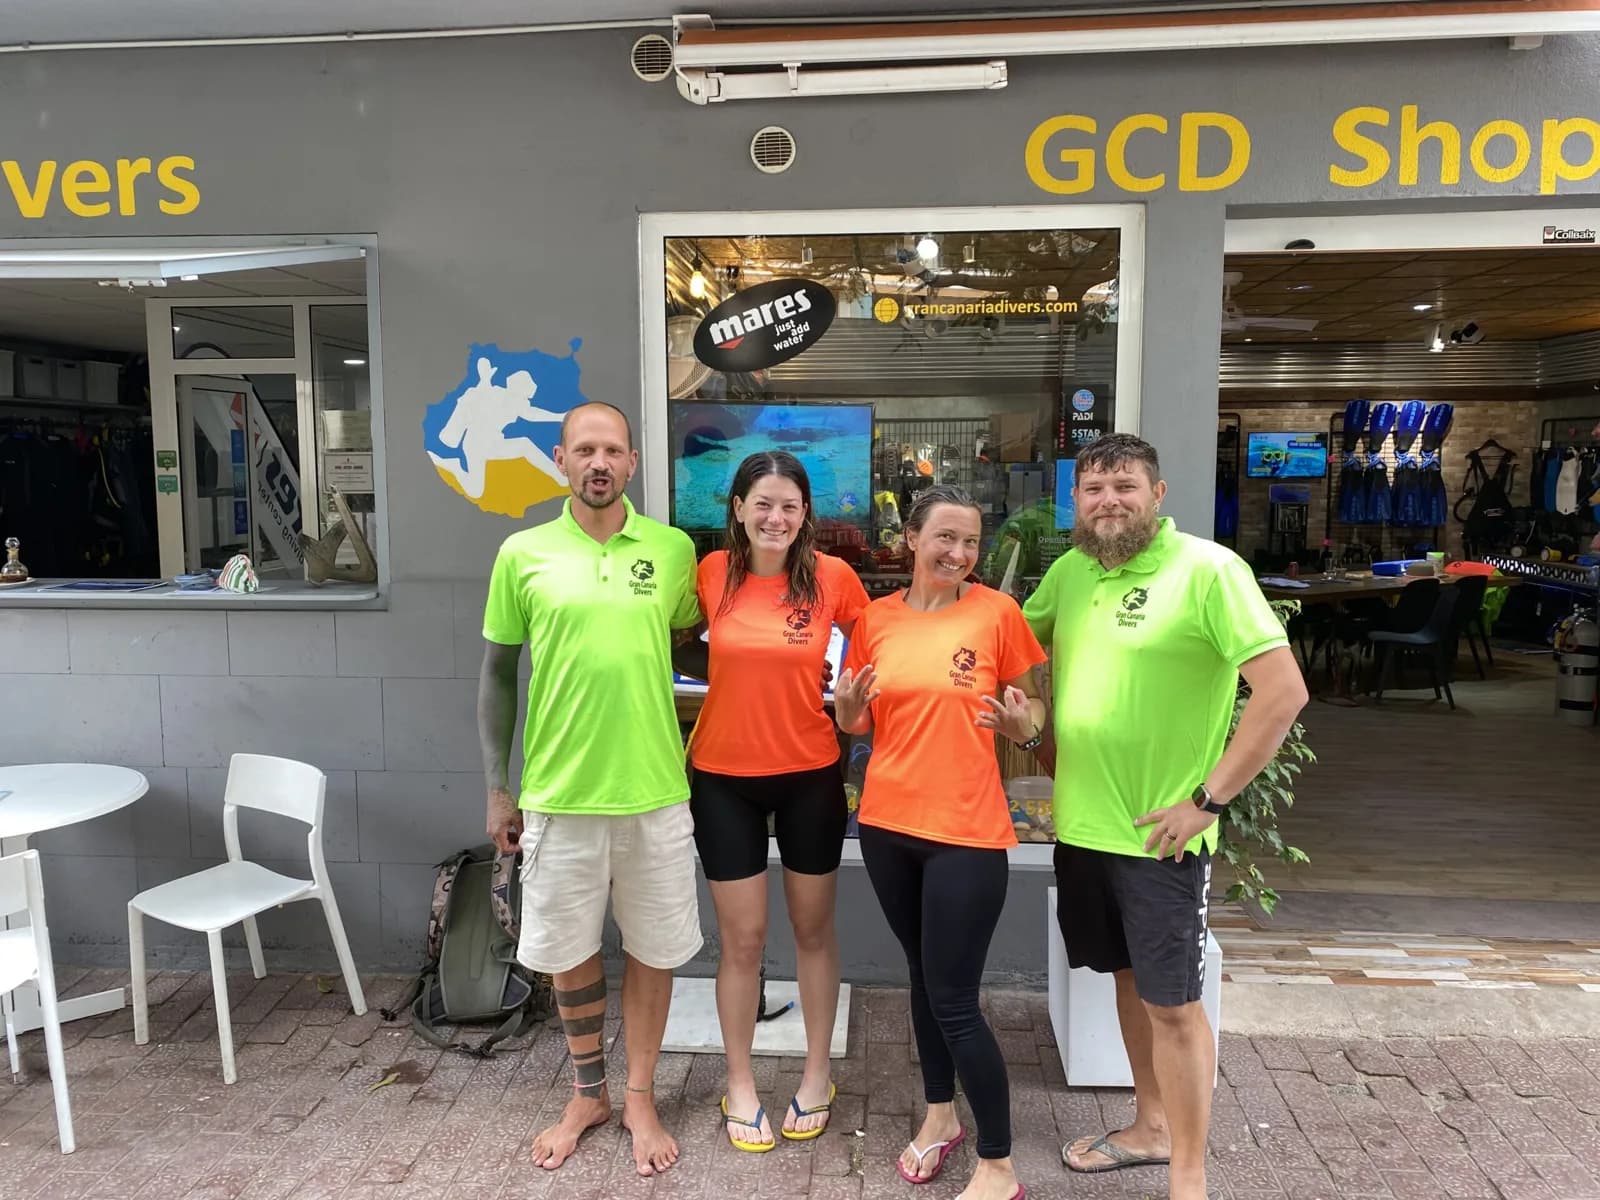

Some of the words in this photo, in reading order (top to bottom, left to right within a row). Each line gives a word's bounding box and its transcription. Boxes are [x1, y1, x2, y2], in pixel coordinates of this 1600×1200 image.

[1024, 112, 1251, 194] GCD
[1329, 104, 1600, 196] Shop
[1, 155, 200, 218] vers
[709, 289, 812, 345] mares
[774, 319, 796, 336] just
[791, 321, 810, 337] add
[773, 334, 804, 351] water
[1072, 411, 1094, 421] PADI
